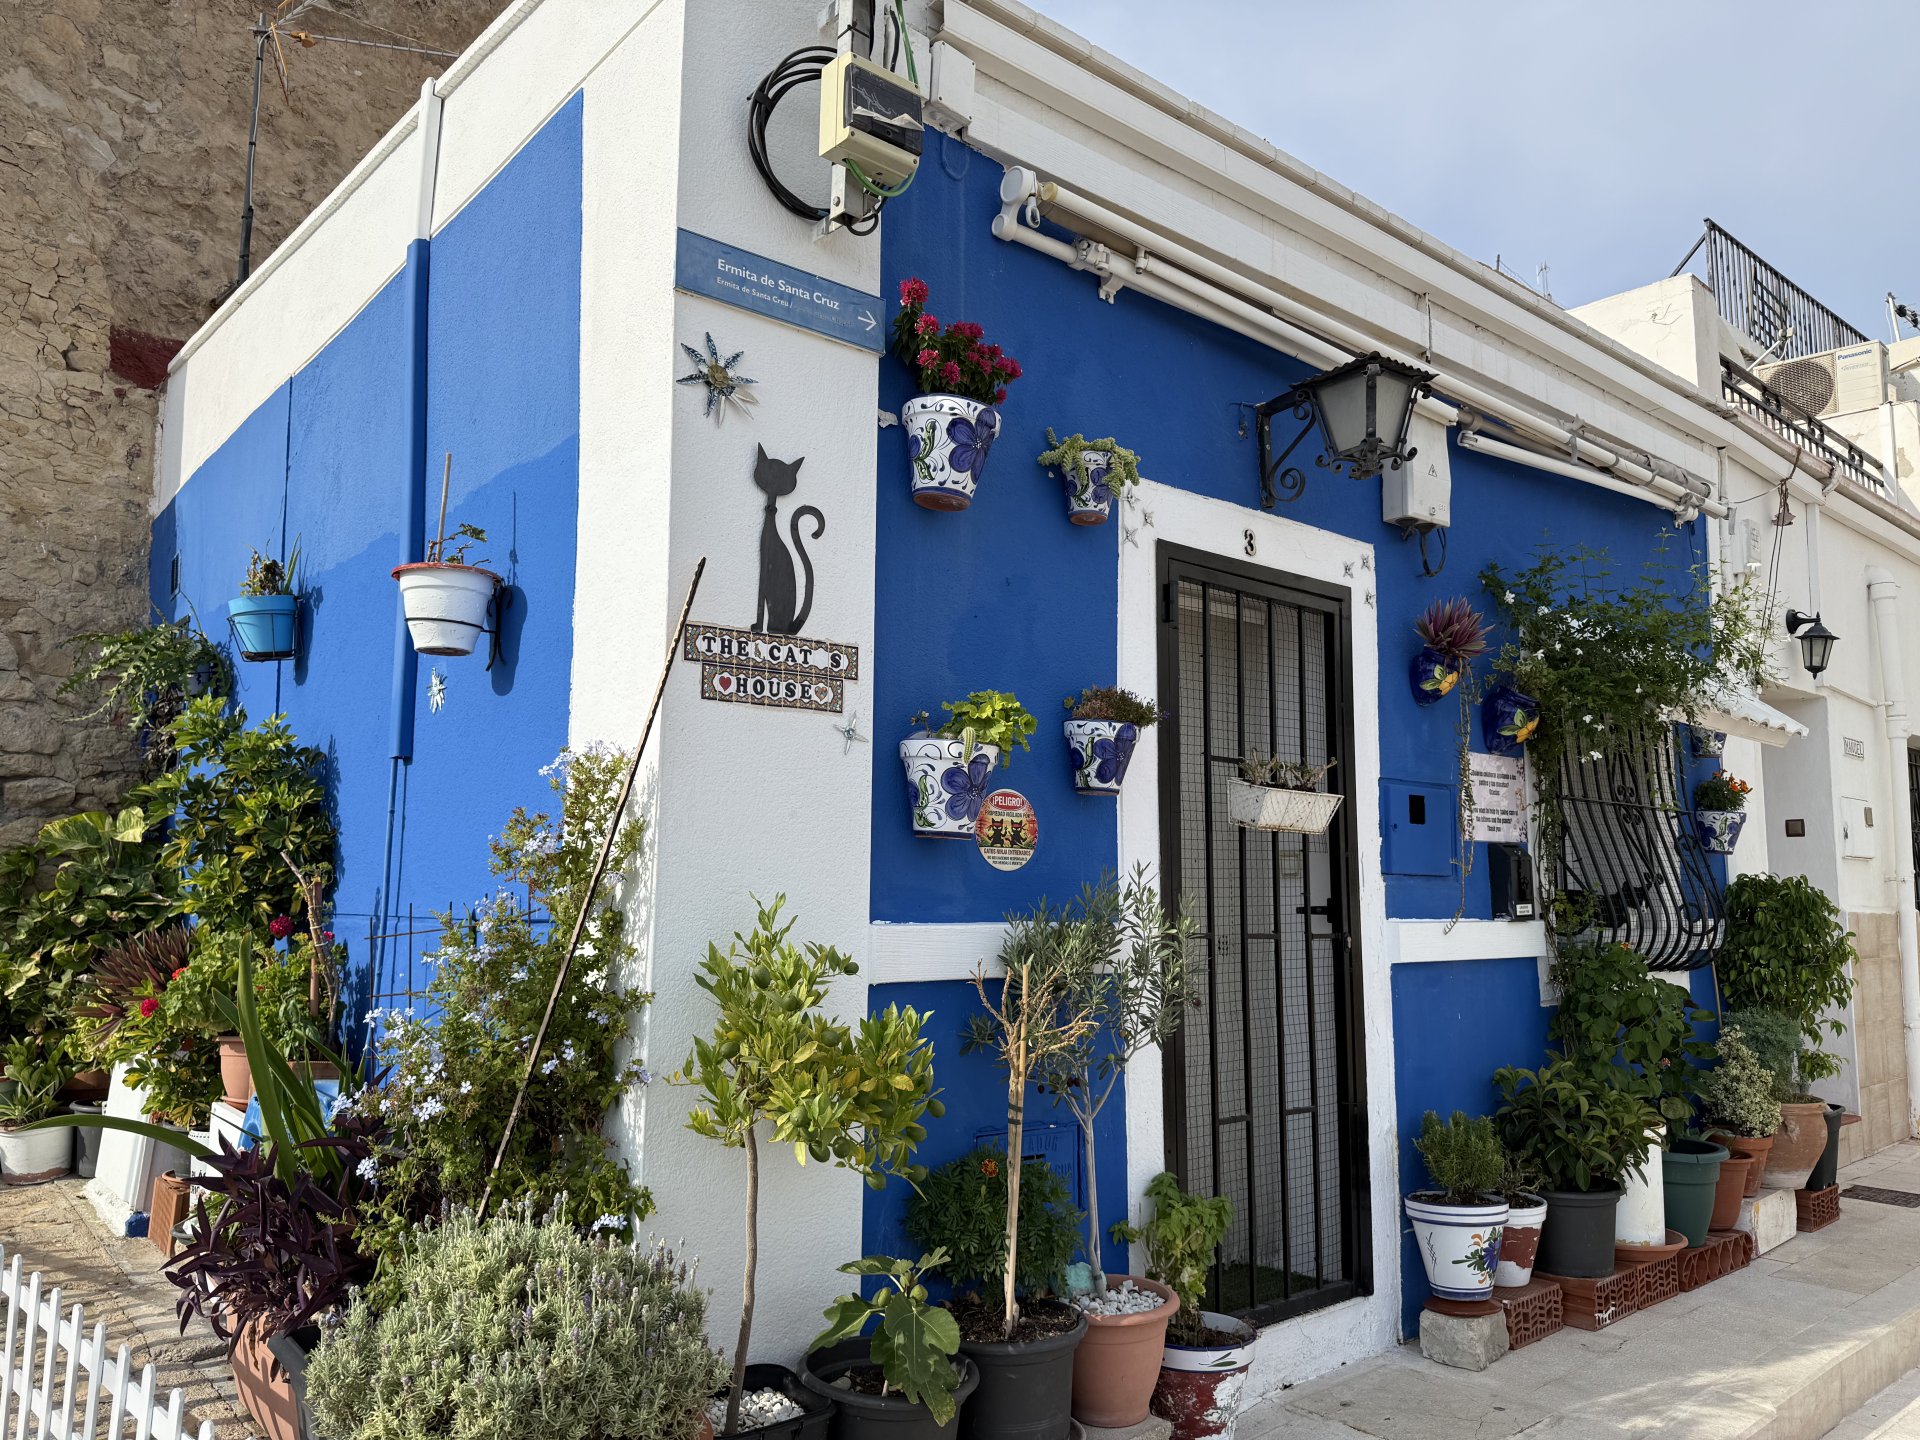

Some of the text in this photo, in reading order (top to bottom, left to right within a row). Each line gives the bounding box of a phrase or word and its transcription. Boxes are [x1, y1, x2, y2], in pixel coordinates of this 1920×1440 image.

[716, 277, 740, 291] Ermita
[741, 285, 750, 294] de
[751, 289, 771, 301] Santa
[772, 296, 789, 307] Creu
[717, 258, 840, 310] Ermita de Santa Cruz
[1838, 348, 1872, 360] Panasonic
[1242, 528, 1257, 557] 3
[702, 635, 749, 657] THE
[768, 644, 812, 665] CAT
[735, 677, 813, 700] HOUSE
[992, 795, 1023, 807] ¡PELIGRO!
